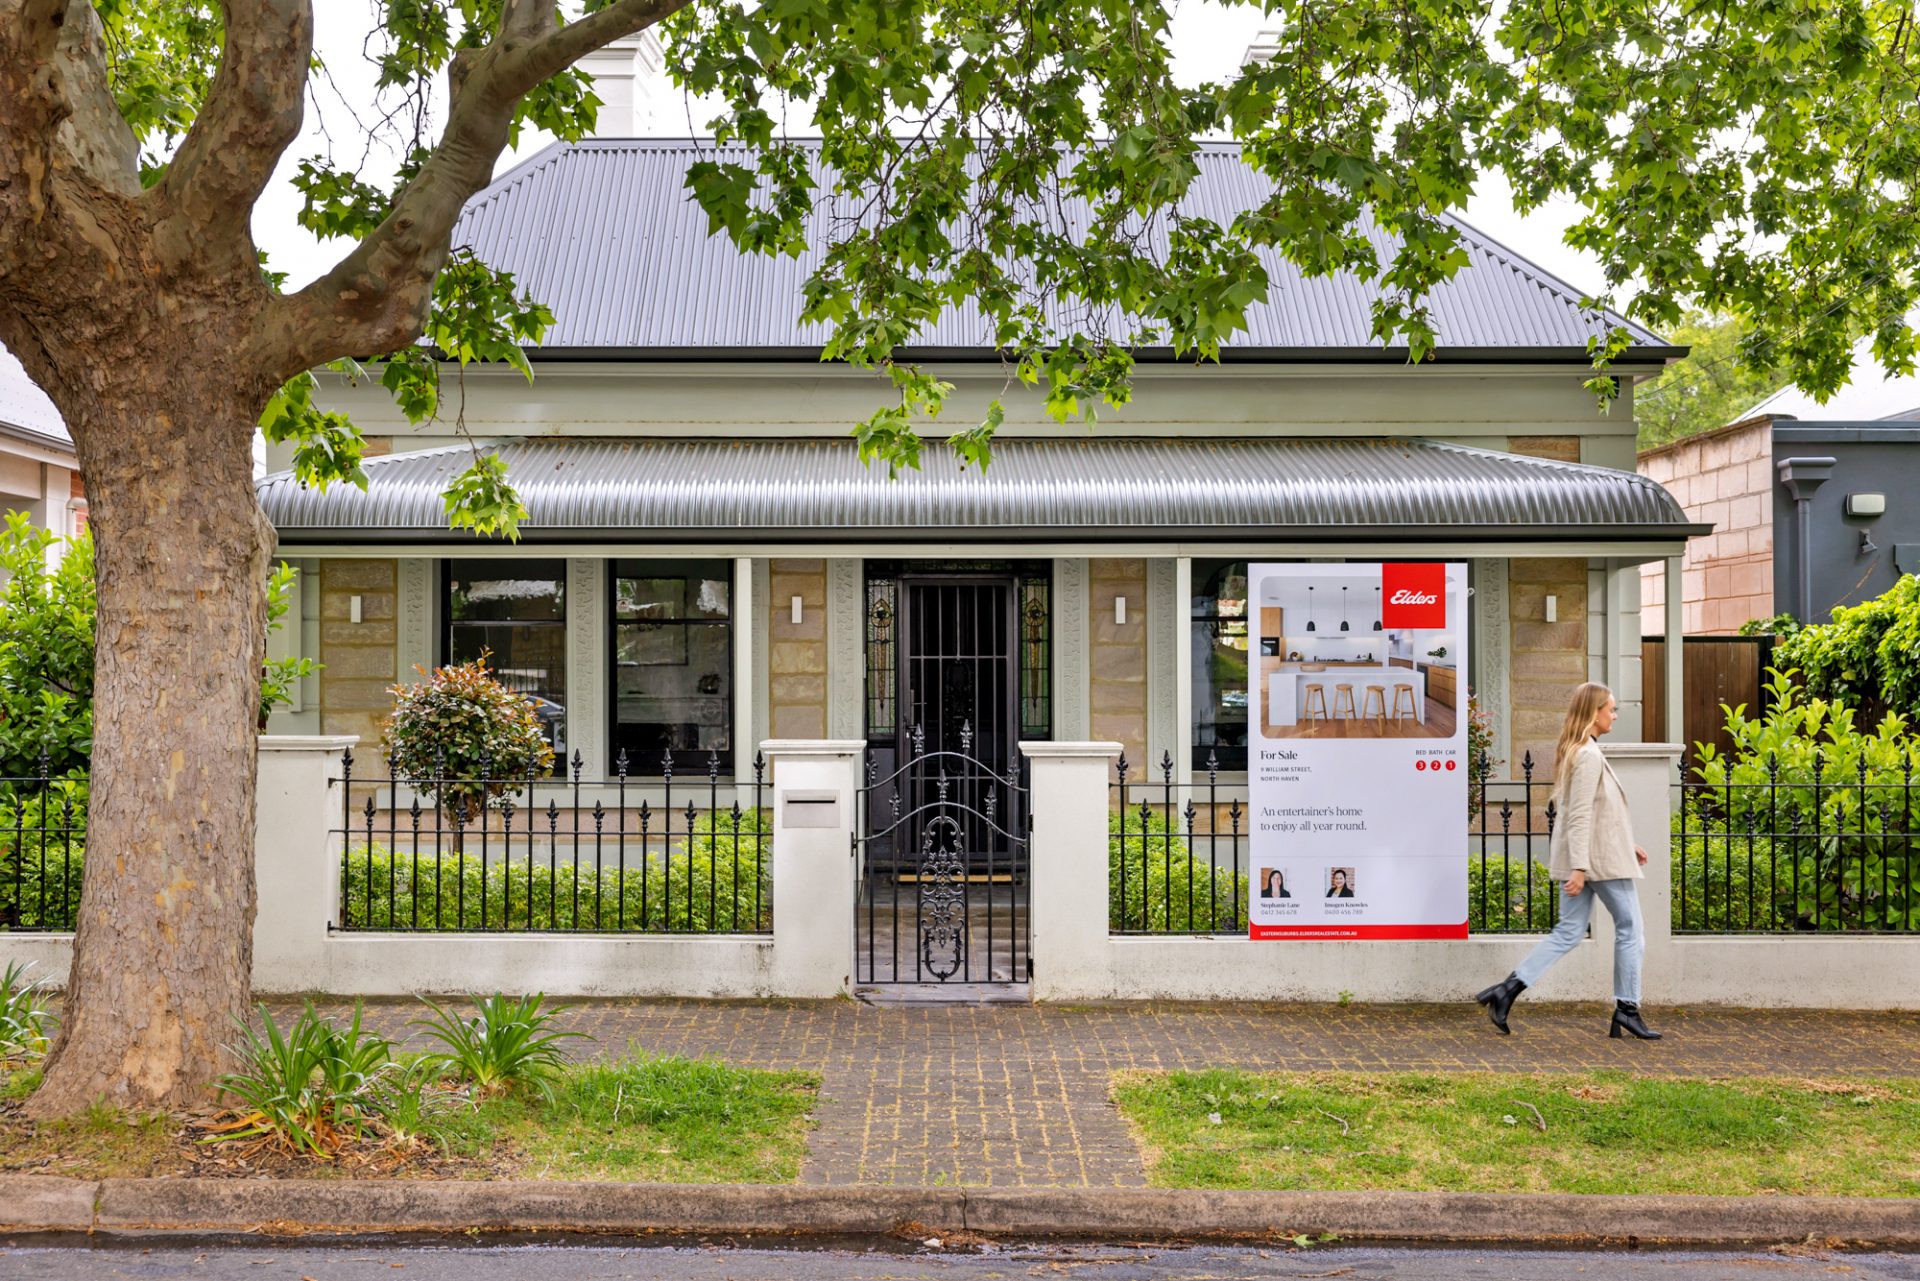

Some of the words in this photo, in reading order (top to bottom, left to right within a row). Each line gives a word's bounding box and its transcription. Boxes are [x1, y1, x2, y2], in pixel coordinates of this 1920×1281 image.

[1390, 589, 1438, 605] Elders
[1260, 750, 1276, 760] For
[1278, 750, 1298, 760] Sale
[1260, 806, 1275, 816] An
[1277, 806, 1334, 816] entertainer's
[1336, 806, 1363, 816] home
[1260, 821, 1270, 831] to
[1272, 821, 1298, 833] enjoy
[1299, 820, 1311, 831] all
[1313, 822, 1333, 833] year
[1335, 820, 1367, 831] round.
